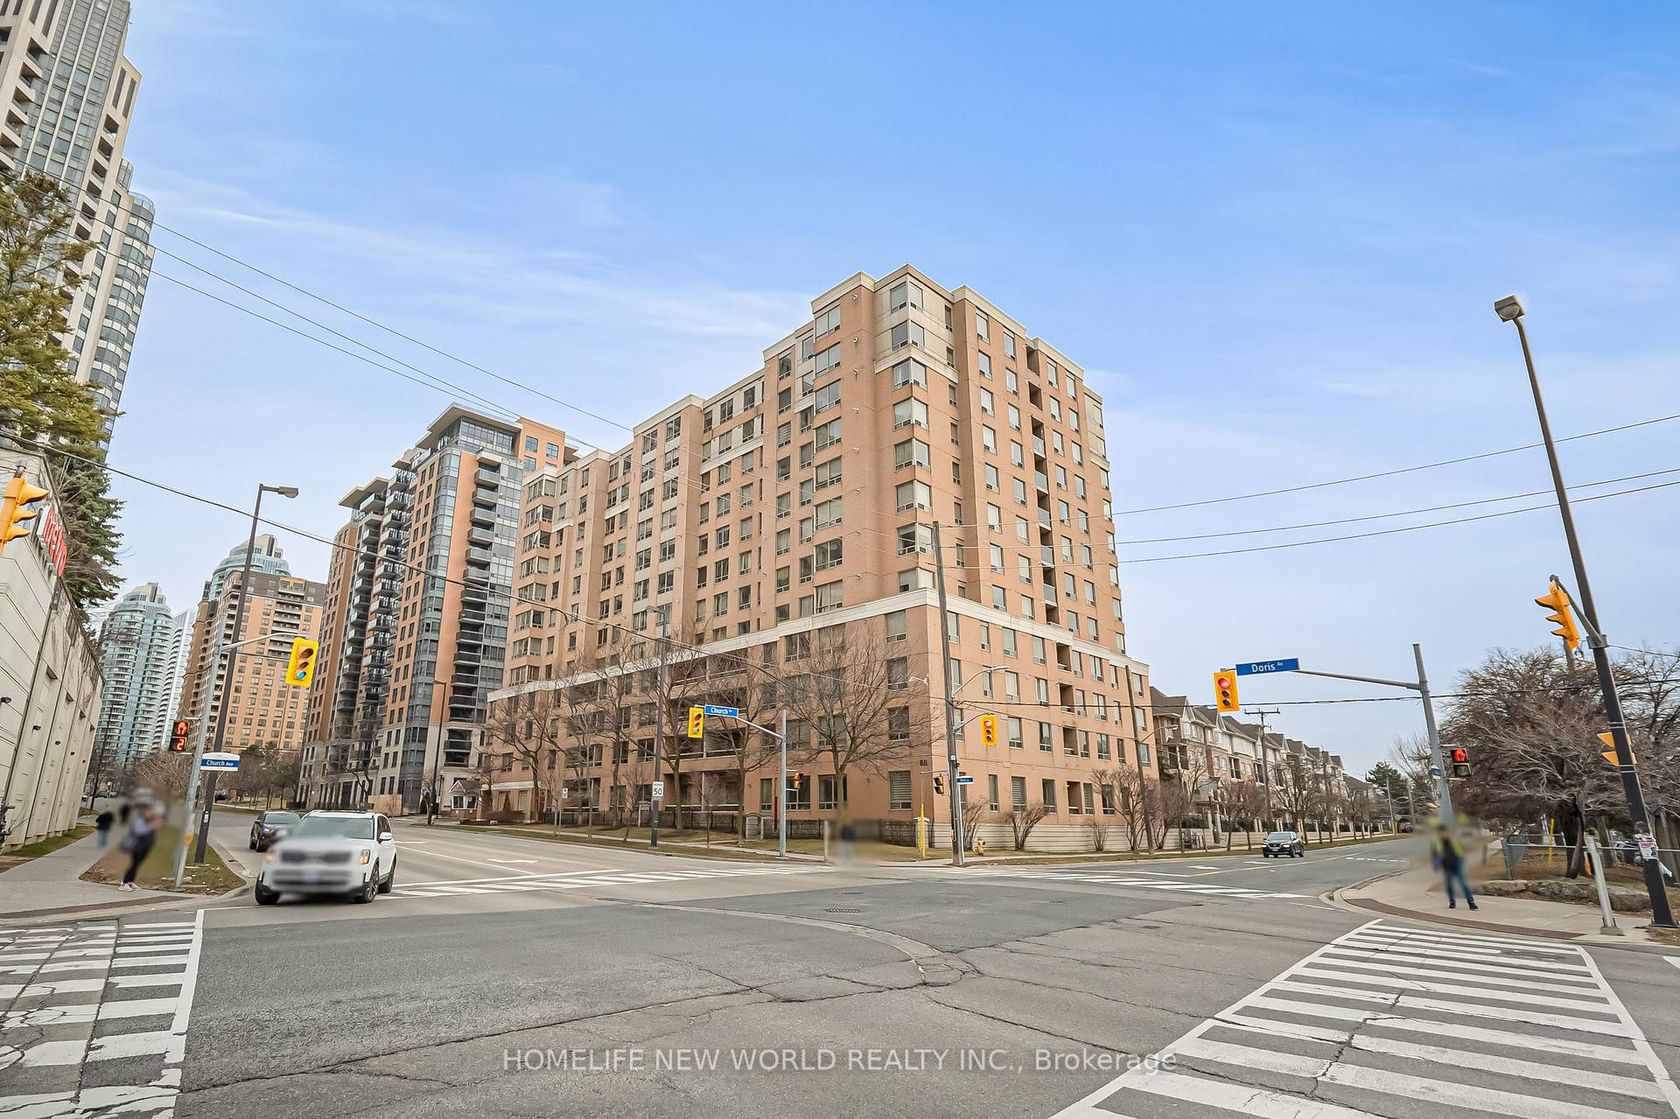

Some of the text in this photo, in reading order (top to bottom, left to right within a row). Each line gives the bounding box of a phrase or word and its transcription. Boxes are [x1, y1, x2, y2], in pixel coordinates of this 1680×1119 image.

[1251, 662, 1276, 672] Doris
[710, 707, 729, 715] Church
[653, 787, 663, 796] 50
